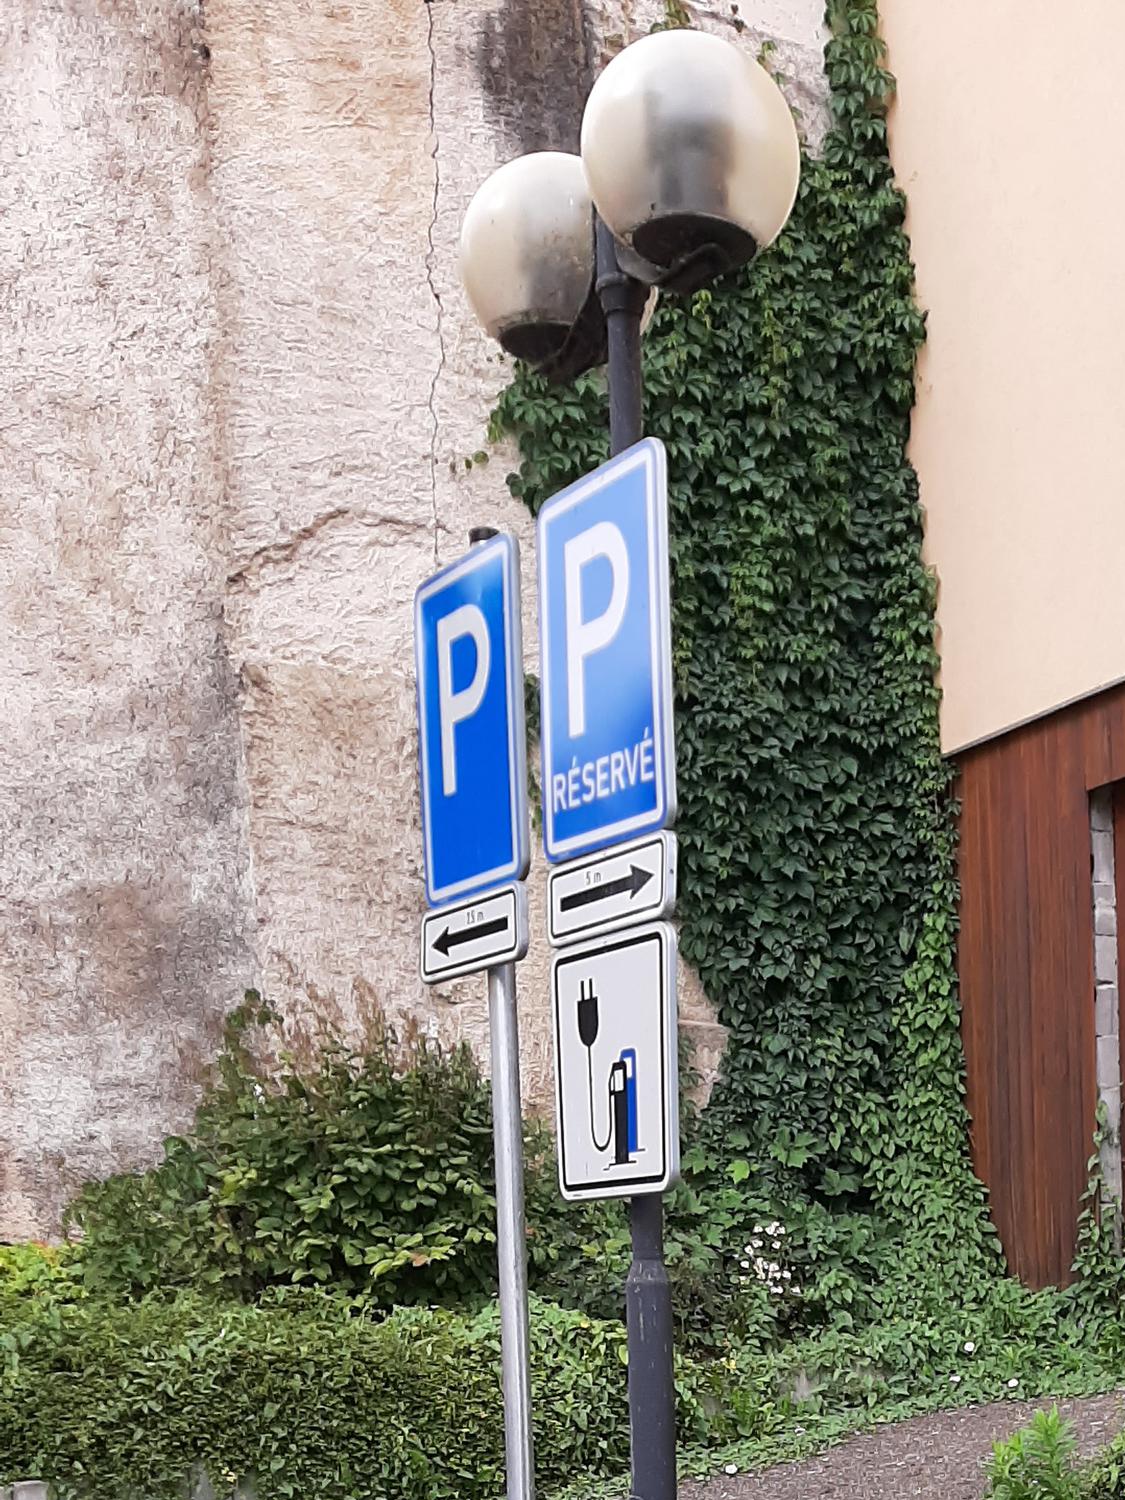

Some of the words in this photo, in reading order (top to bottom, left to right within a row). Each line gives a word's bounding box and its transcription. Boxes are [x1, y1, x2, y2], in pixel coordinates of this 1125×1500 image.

[436, 603, 490, 797] P
[564, 521, 630, 739] P
[553, 726, 654, 814] RÉSERVÉ
[585, 871, 592, 885] 5
[593, 871, 602, 884] m
